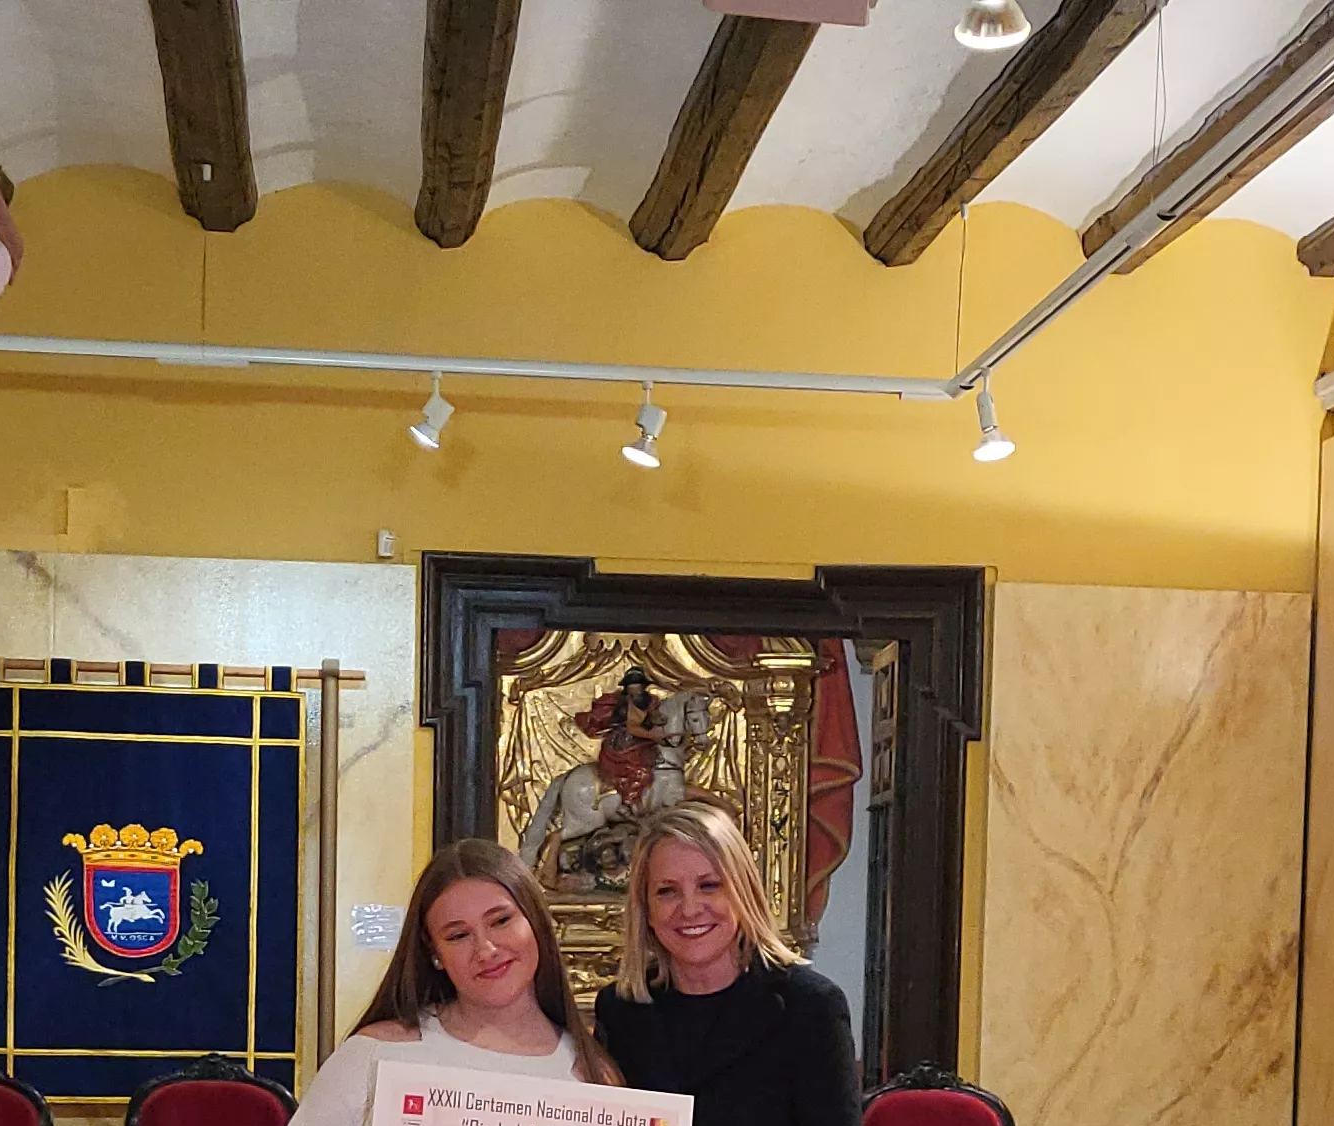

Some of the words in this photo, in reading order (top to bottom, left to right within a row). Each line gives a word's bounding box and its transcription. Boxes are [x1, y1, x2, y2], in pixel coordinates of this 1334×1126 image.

[427, 1087, 462, 1109] XXXII
[465, 1092, 532, 1116] Certamen
[536, 1099, 594, 1123] Nacional
[597, 1107, 613, 1126] de
